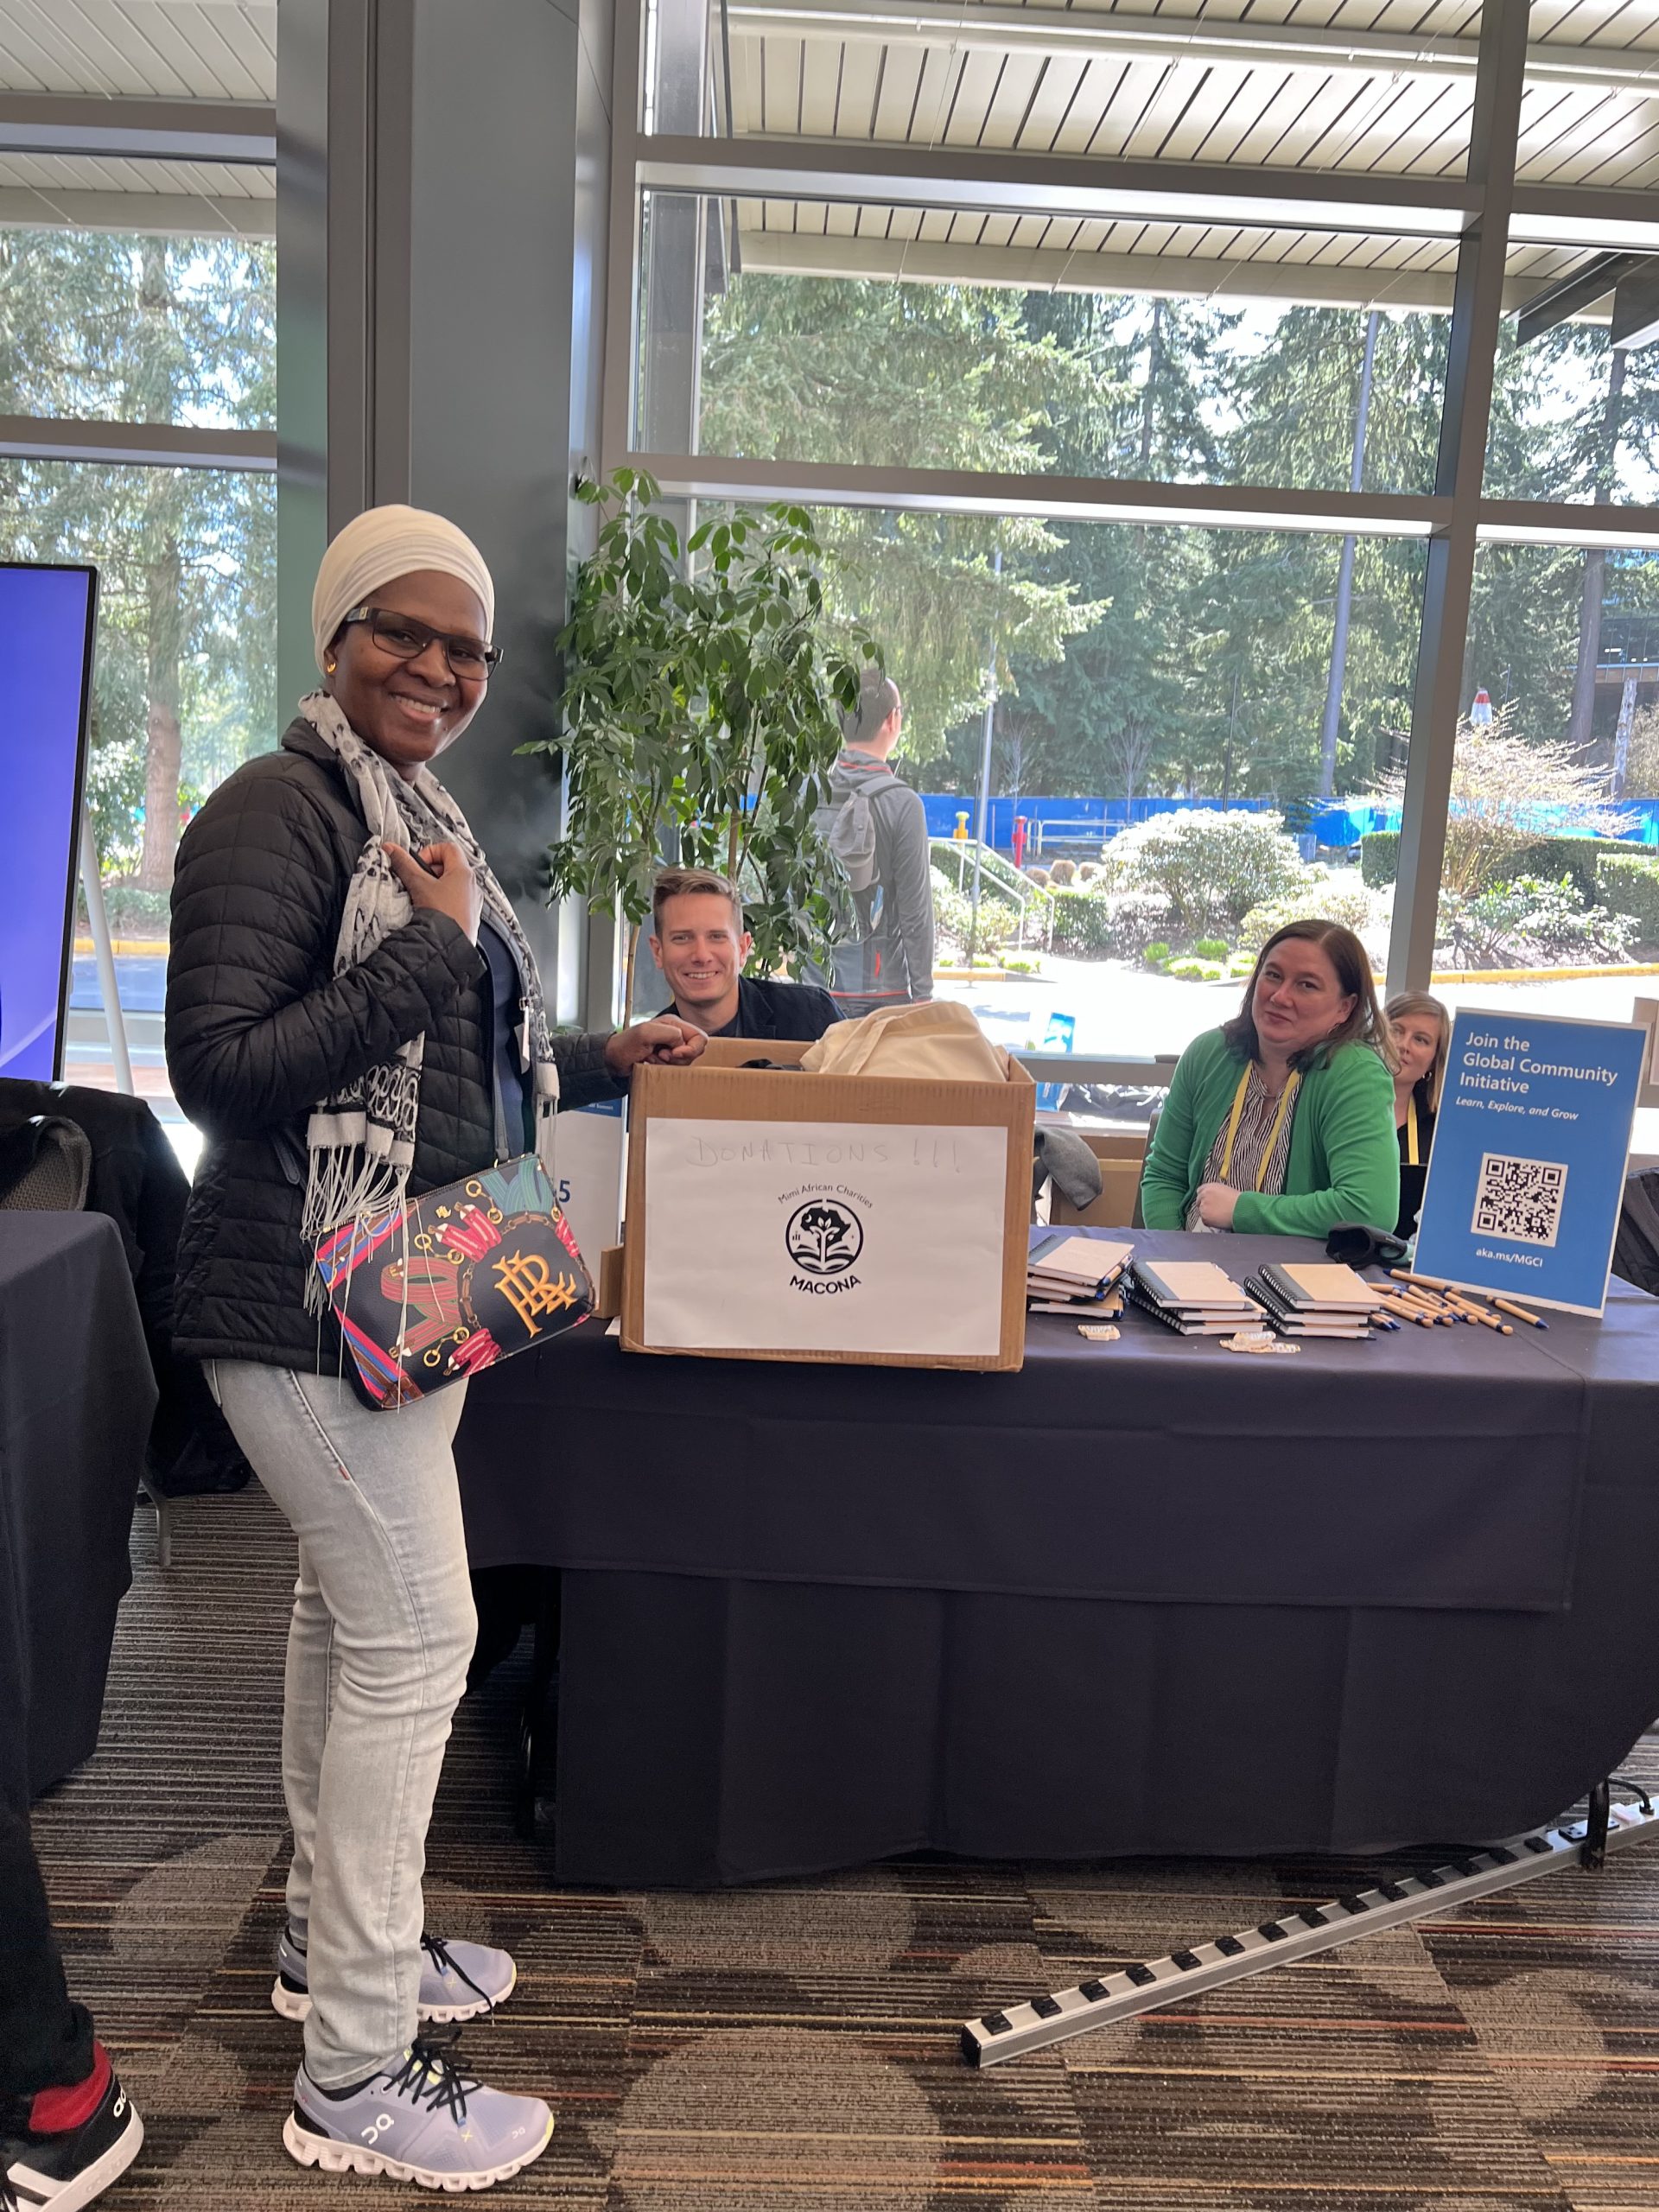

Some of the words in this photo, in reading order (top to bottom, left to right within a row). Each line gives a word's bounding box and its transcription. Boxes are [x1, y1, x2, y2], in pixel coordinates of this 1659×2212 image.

[1466, 1032, 1498, 1048] Join
[1503, 1036, 1530, 1052] the
[1463, 1052, 1515, 1071] Global
[1519, 1058, 1618, 1086] Community
[1460, 1071, 1529, 1094] Initiative
[1456, 1096, 1484, 1109] Learn,
[1488, 1100, 1526, 1115] Explore,
[1529, 1107, 1549, 1116] and
[1551, 1109, 1580, 1121] Grow
[554, 1179, 570, 1203] 5
[778, 1189, 800, 1205] Mimi
[801, 1183, 833, 1194] African
[836, 1184, 874, 1209] Charities
[1476, 1247, 1543, 1268] aka.ms/MGCI
[789, 1274, 861, 1294] MACONA
